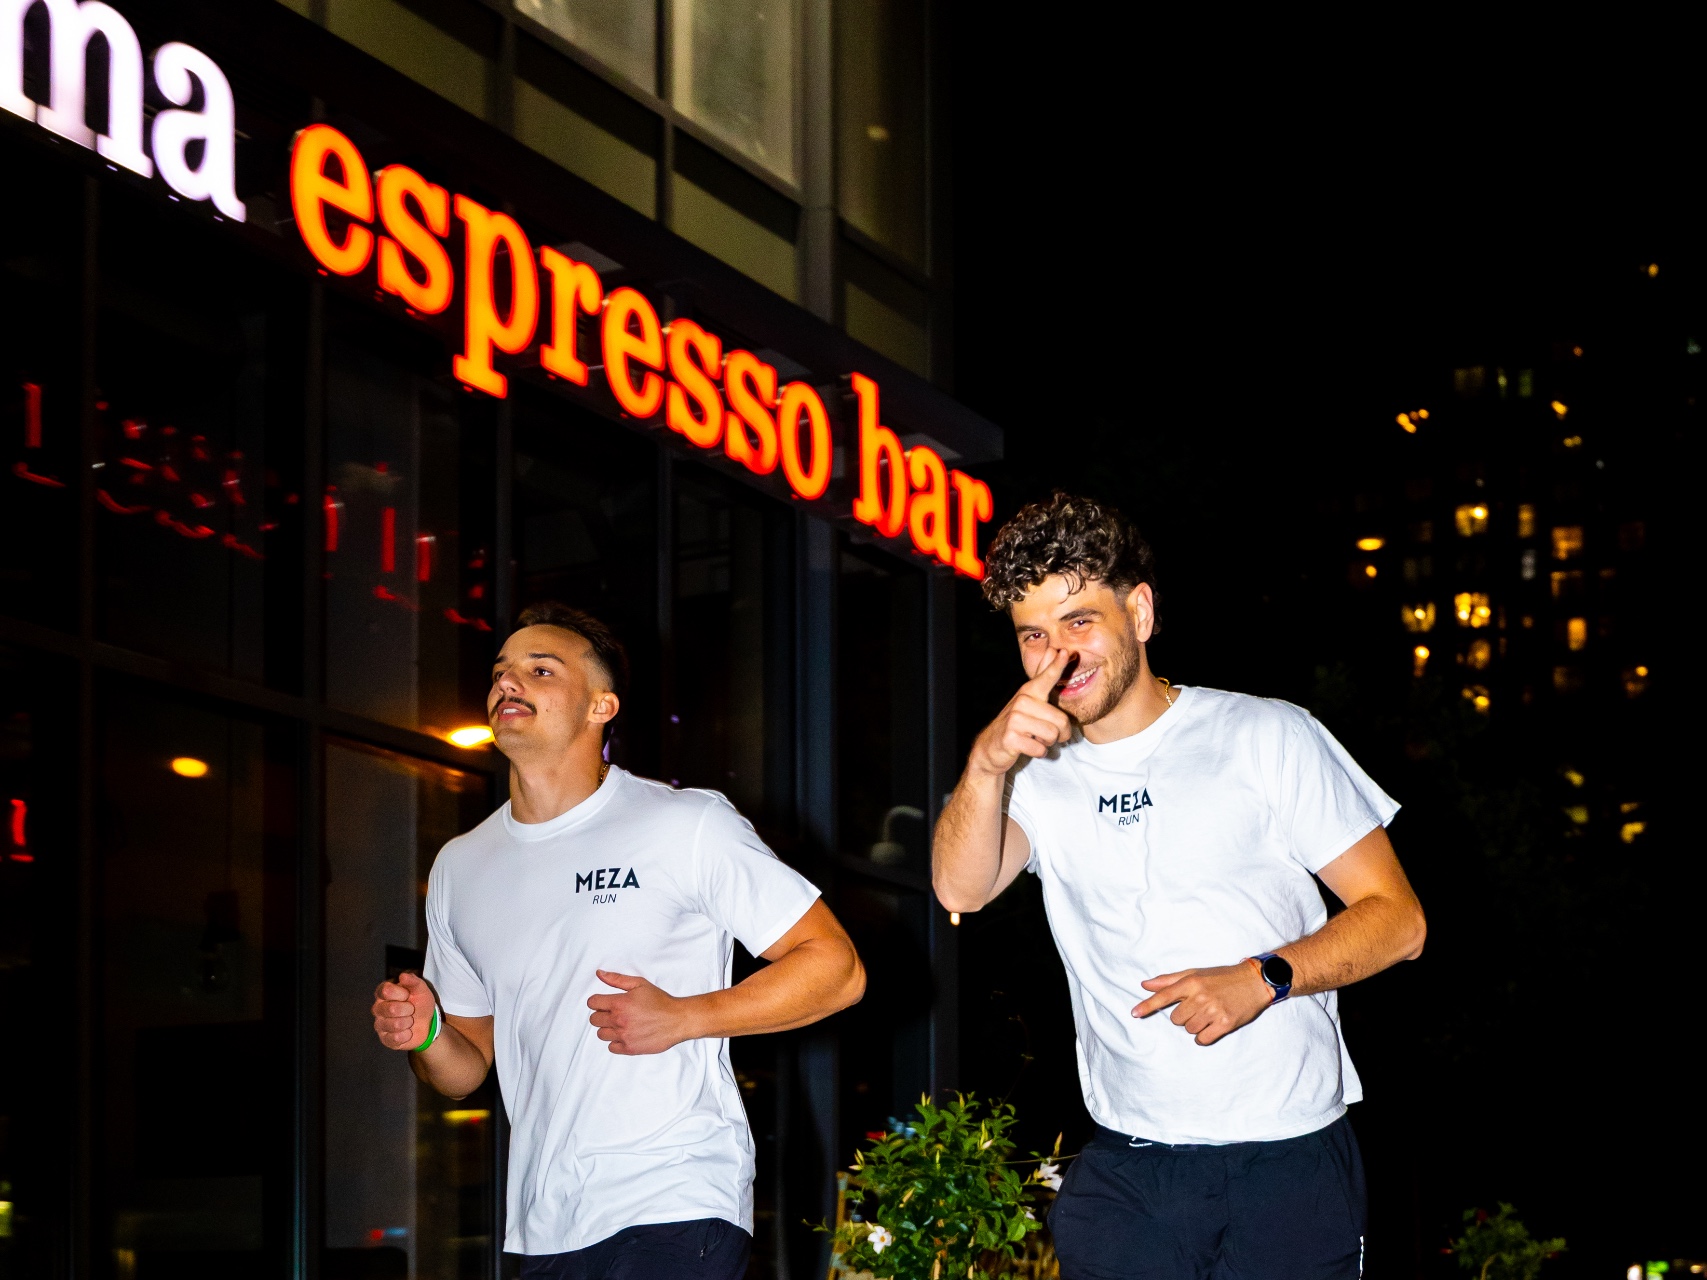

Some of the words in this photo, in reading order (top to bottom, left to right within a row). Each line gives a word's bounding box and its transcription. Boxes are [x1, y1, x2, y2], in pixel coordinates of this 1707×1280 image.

[290, 123, 833, 500] espresso
[852, 372, 993, 580] bar
[1098, 787, 1154, 813] MEZA
[1118, 813, 1140, 826] RUN
[575, 866, 641, 894] MEZA
[592, 893, 617, 905] RUN
